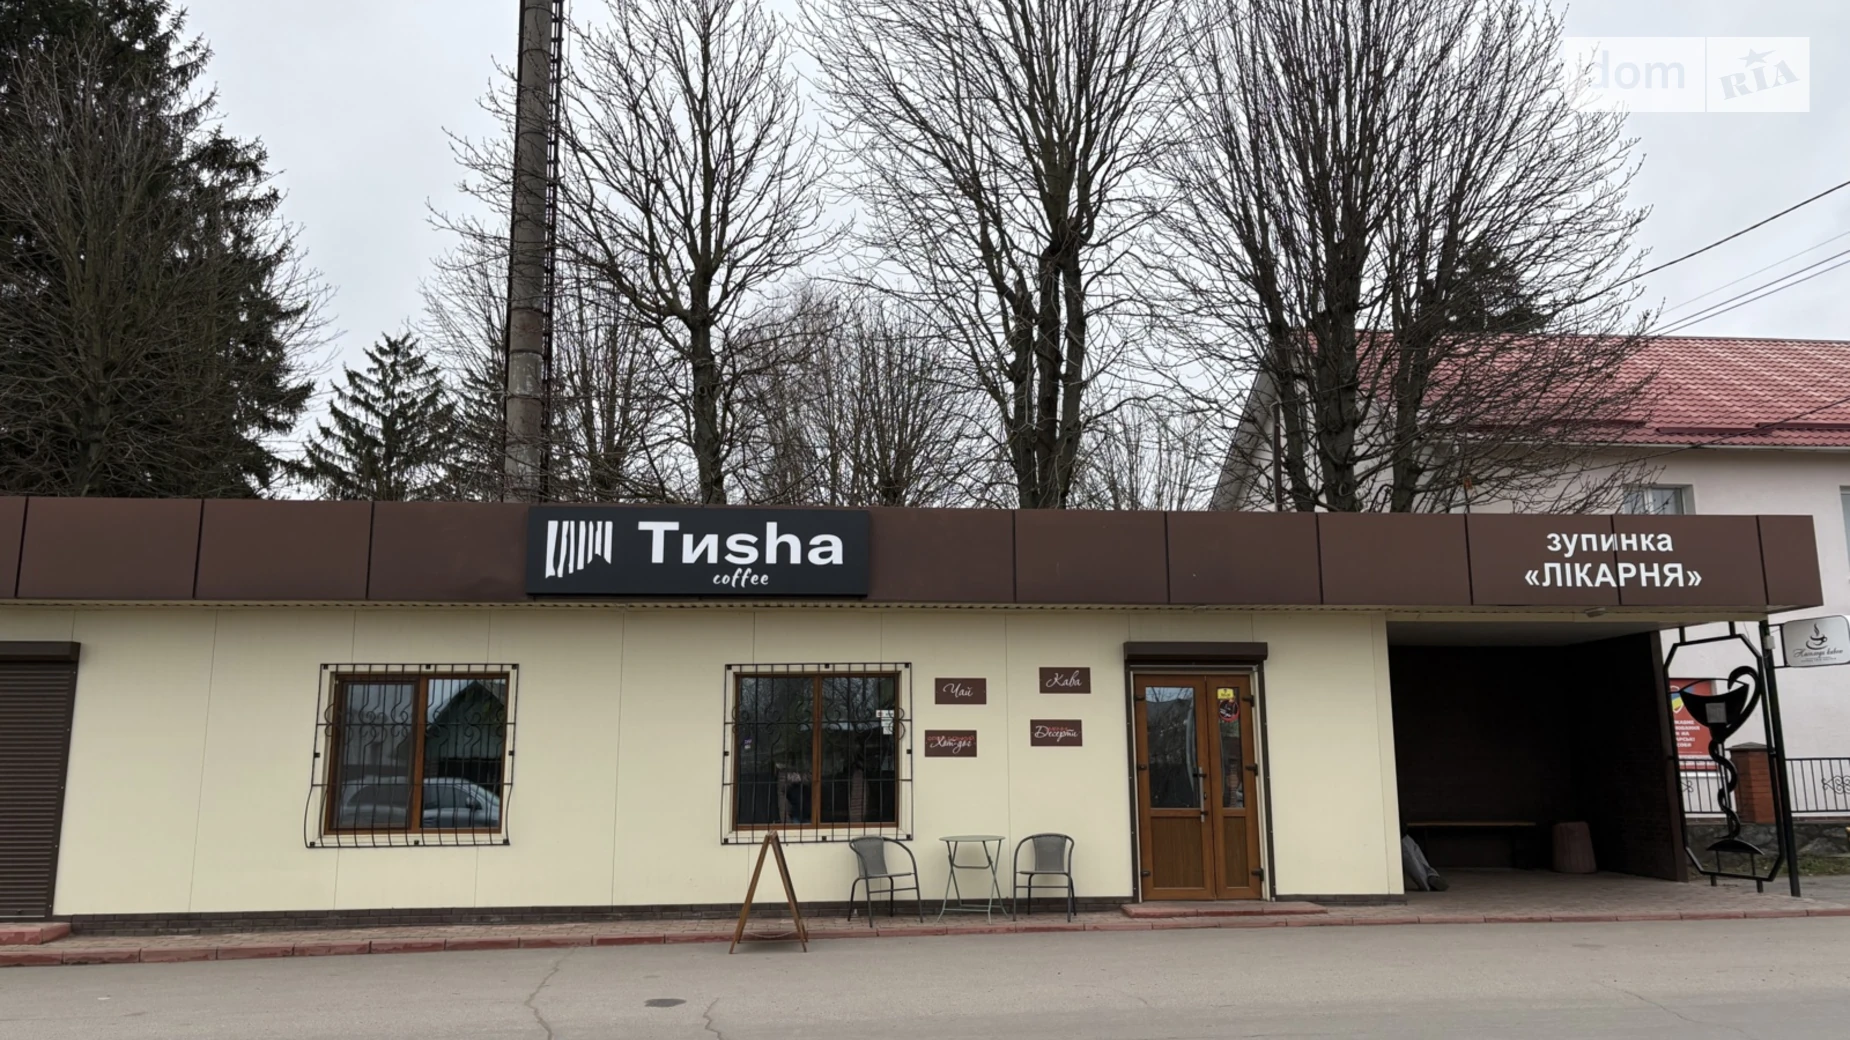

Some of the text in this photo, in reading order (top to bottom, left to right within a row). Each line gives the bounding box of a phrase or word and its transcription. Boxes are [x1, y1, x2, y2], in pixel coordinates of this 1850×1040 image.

[1546, 532, 1674, 558] зупинка
[712, 567, 769, 588] coffee
[1524, 562, 1703, 588] «ЛІКАРНЯ»
[1045, 670, 1082, 688] Кава
[942, 683, 974, 698] Чай
[1034, 725, 1079, 742] Десерти
